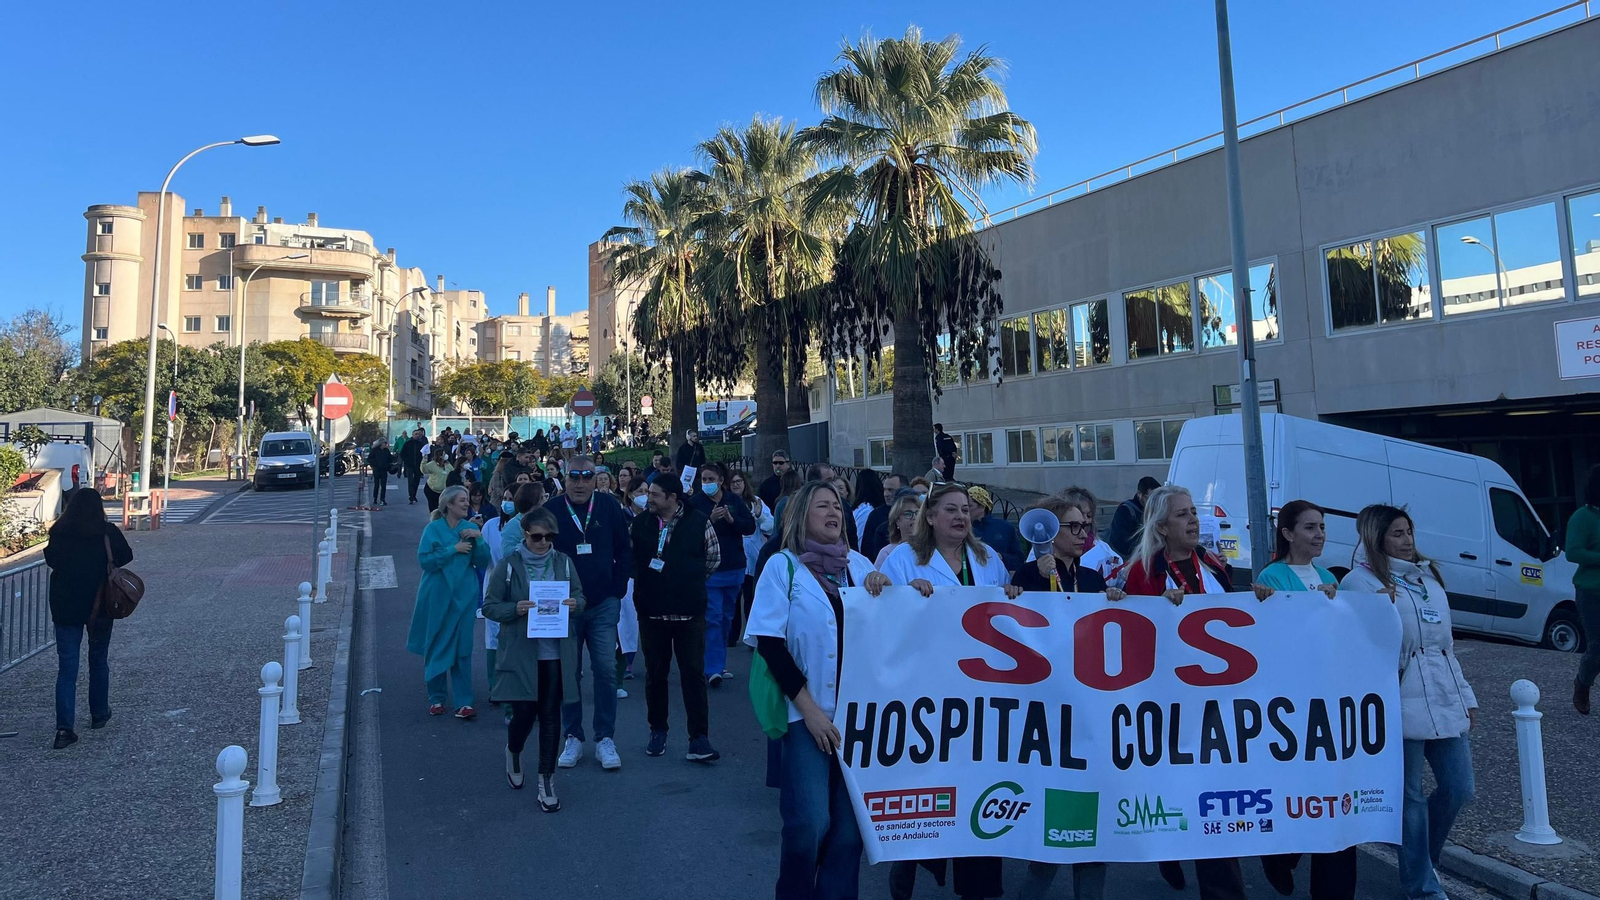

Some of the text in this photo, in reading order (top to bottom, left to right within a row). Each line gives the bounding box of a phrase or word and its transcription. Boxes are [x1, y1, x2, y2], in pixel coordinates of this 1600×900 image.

[957, 601, 1259, 691] SOS
[844, 693, 1386, 771] HOSPITAL COLAPSADO
[982, 799, 1031, 820] CSIF
[1117, 793, 1168, 829] SMA
[1199, 788, 1273, 817] FTPS
[1286, 796, 1338, 819] UGT
[875, 823, 884, 831] de
[886, 820, 915, 831] sanidad
[923, 819, 956, 828] sectores
[891, 832, 901, 841] de
[902, 831, 940, 840] Andalucía
[1048, 828, 1094, 842] SATSE
[1227, 821, 1254, 833] SMP
